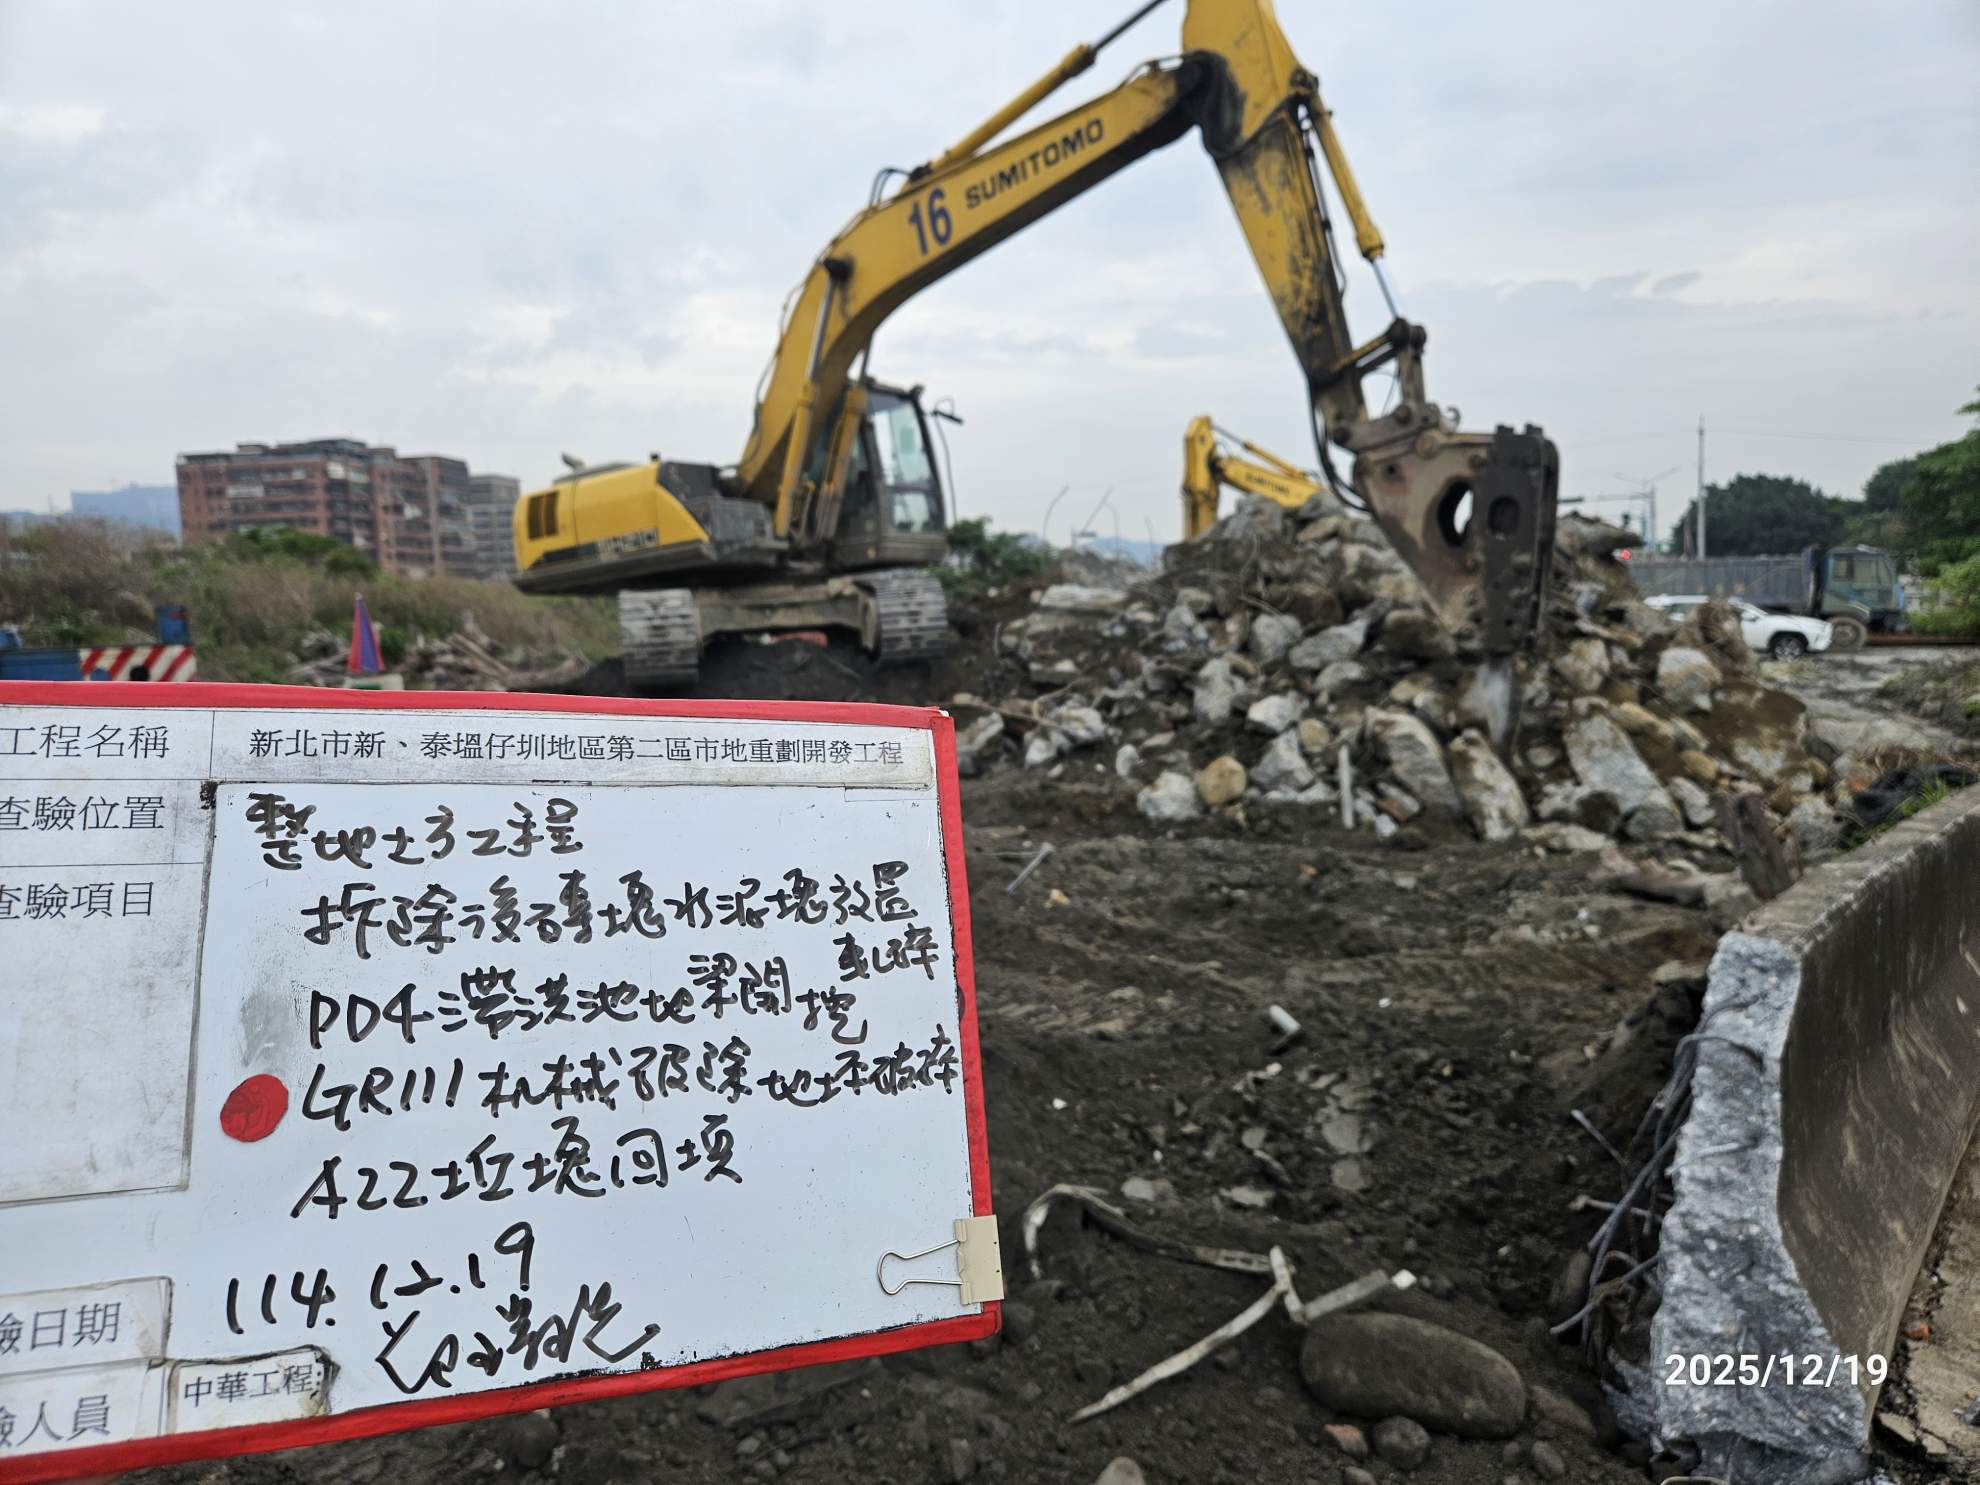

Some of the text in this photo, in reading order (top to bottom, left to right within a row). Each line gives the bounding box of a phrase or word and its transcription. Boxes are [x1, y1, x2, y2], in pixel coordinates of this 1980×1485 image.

[963, 118, 1105, 209] SUMITOMO
[907, 186, 954, 256] 16
[0, 724, 170, 759] 工程名稱
[249, 728, 904, 765] 新北市新、泰塭仔圳地區第二區市地重劃開發工程
[0, 796, 165, 831] 查驗位置
